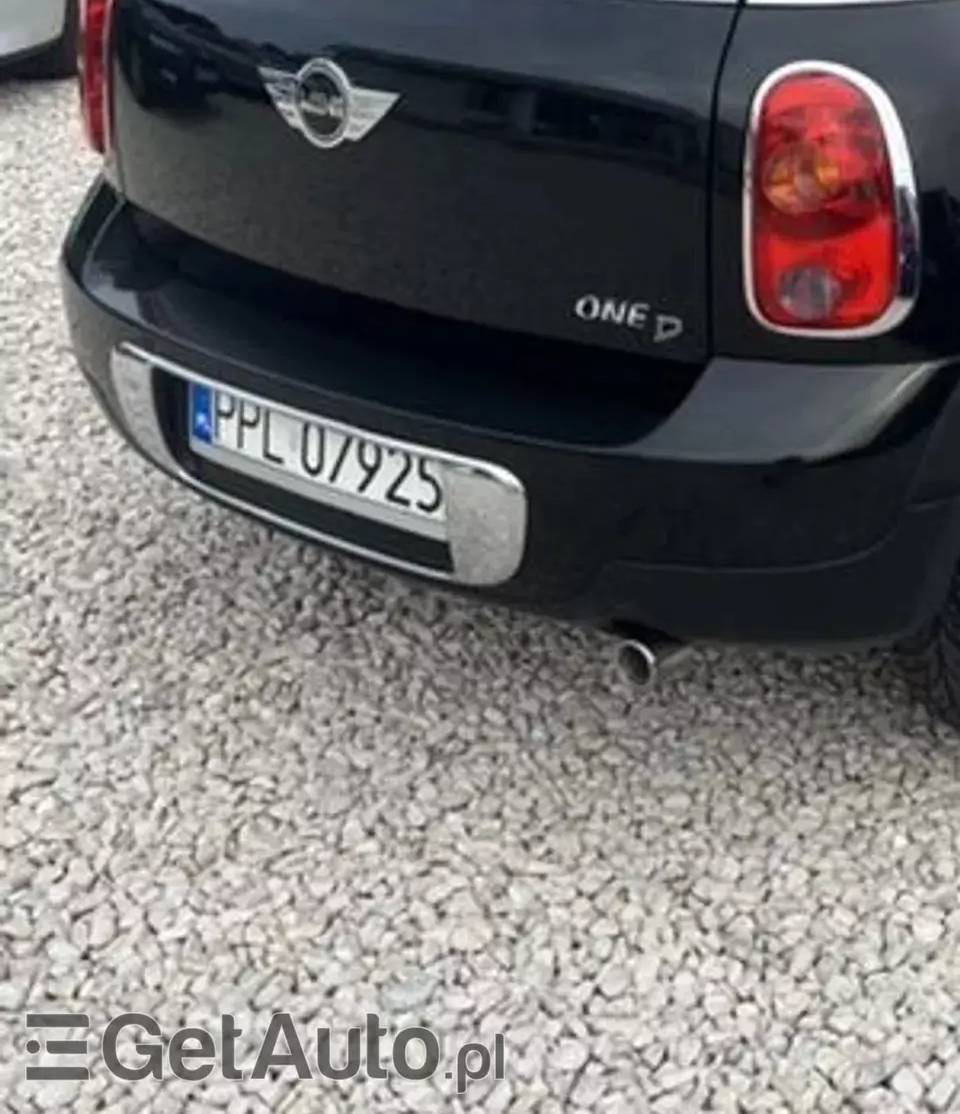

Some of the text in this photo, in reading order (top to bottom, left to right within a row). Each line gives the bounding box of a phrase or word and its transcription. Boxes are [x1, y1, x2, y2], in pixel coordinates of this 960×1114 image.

[575, 294, 683, 343] ONE D
[214, 389, 443, 513] PPL 07925
